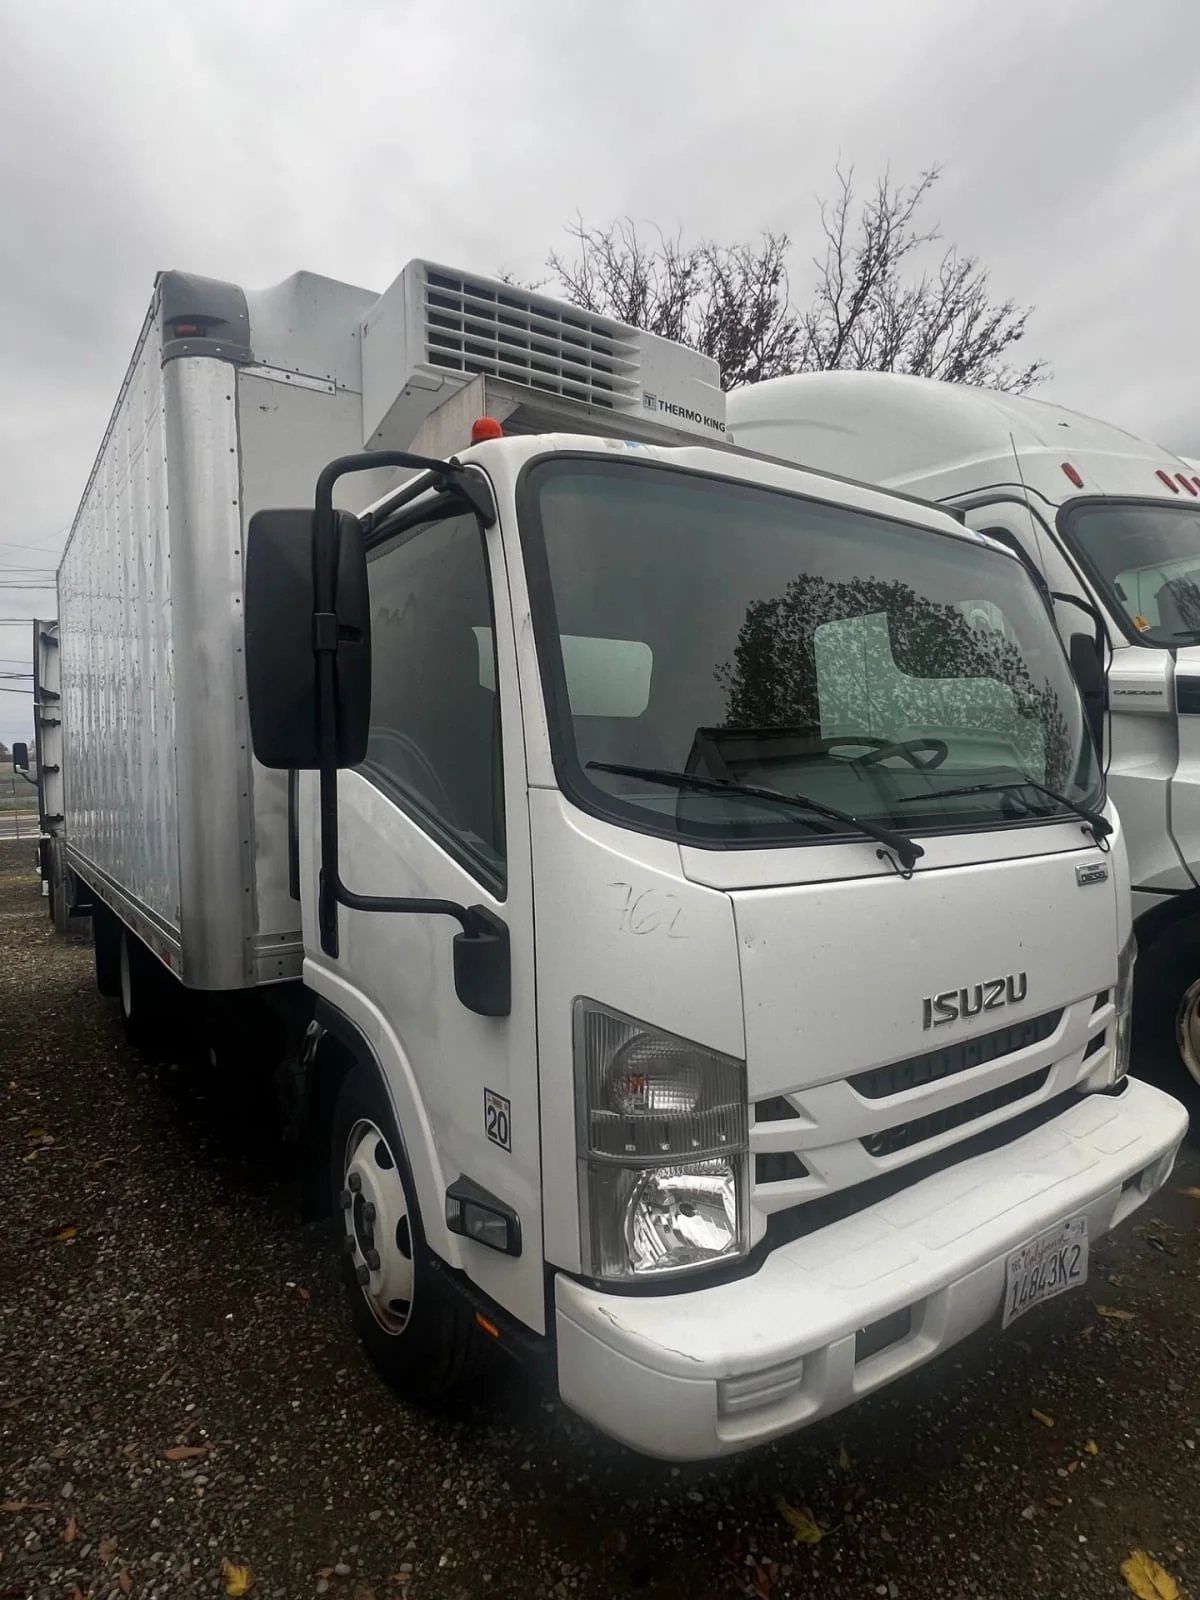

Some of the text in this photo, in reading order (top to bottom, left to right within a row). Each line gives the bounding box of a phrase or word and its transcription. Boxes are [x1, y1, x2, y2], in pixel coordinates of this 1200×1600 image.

[658, 400, 702, 424] THERMO
[703, 415, 726, 433] KING
[922, 971, 1027, 1031] ISUZU
[487, 1104, 508, 1145] 20
[1009, 1243, 1081, 1317] 14843K2
